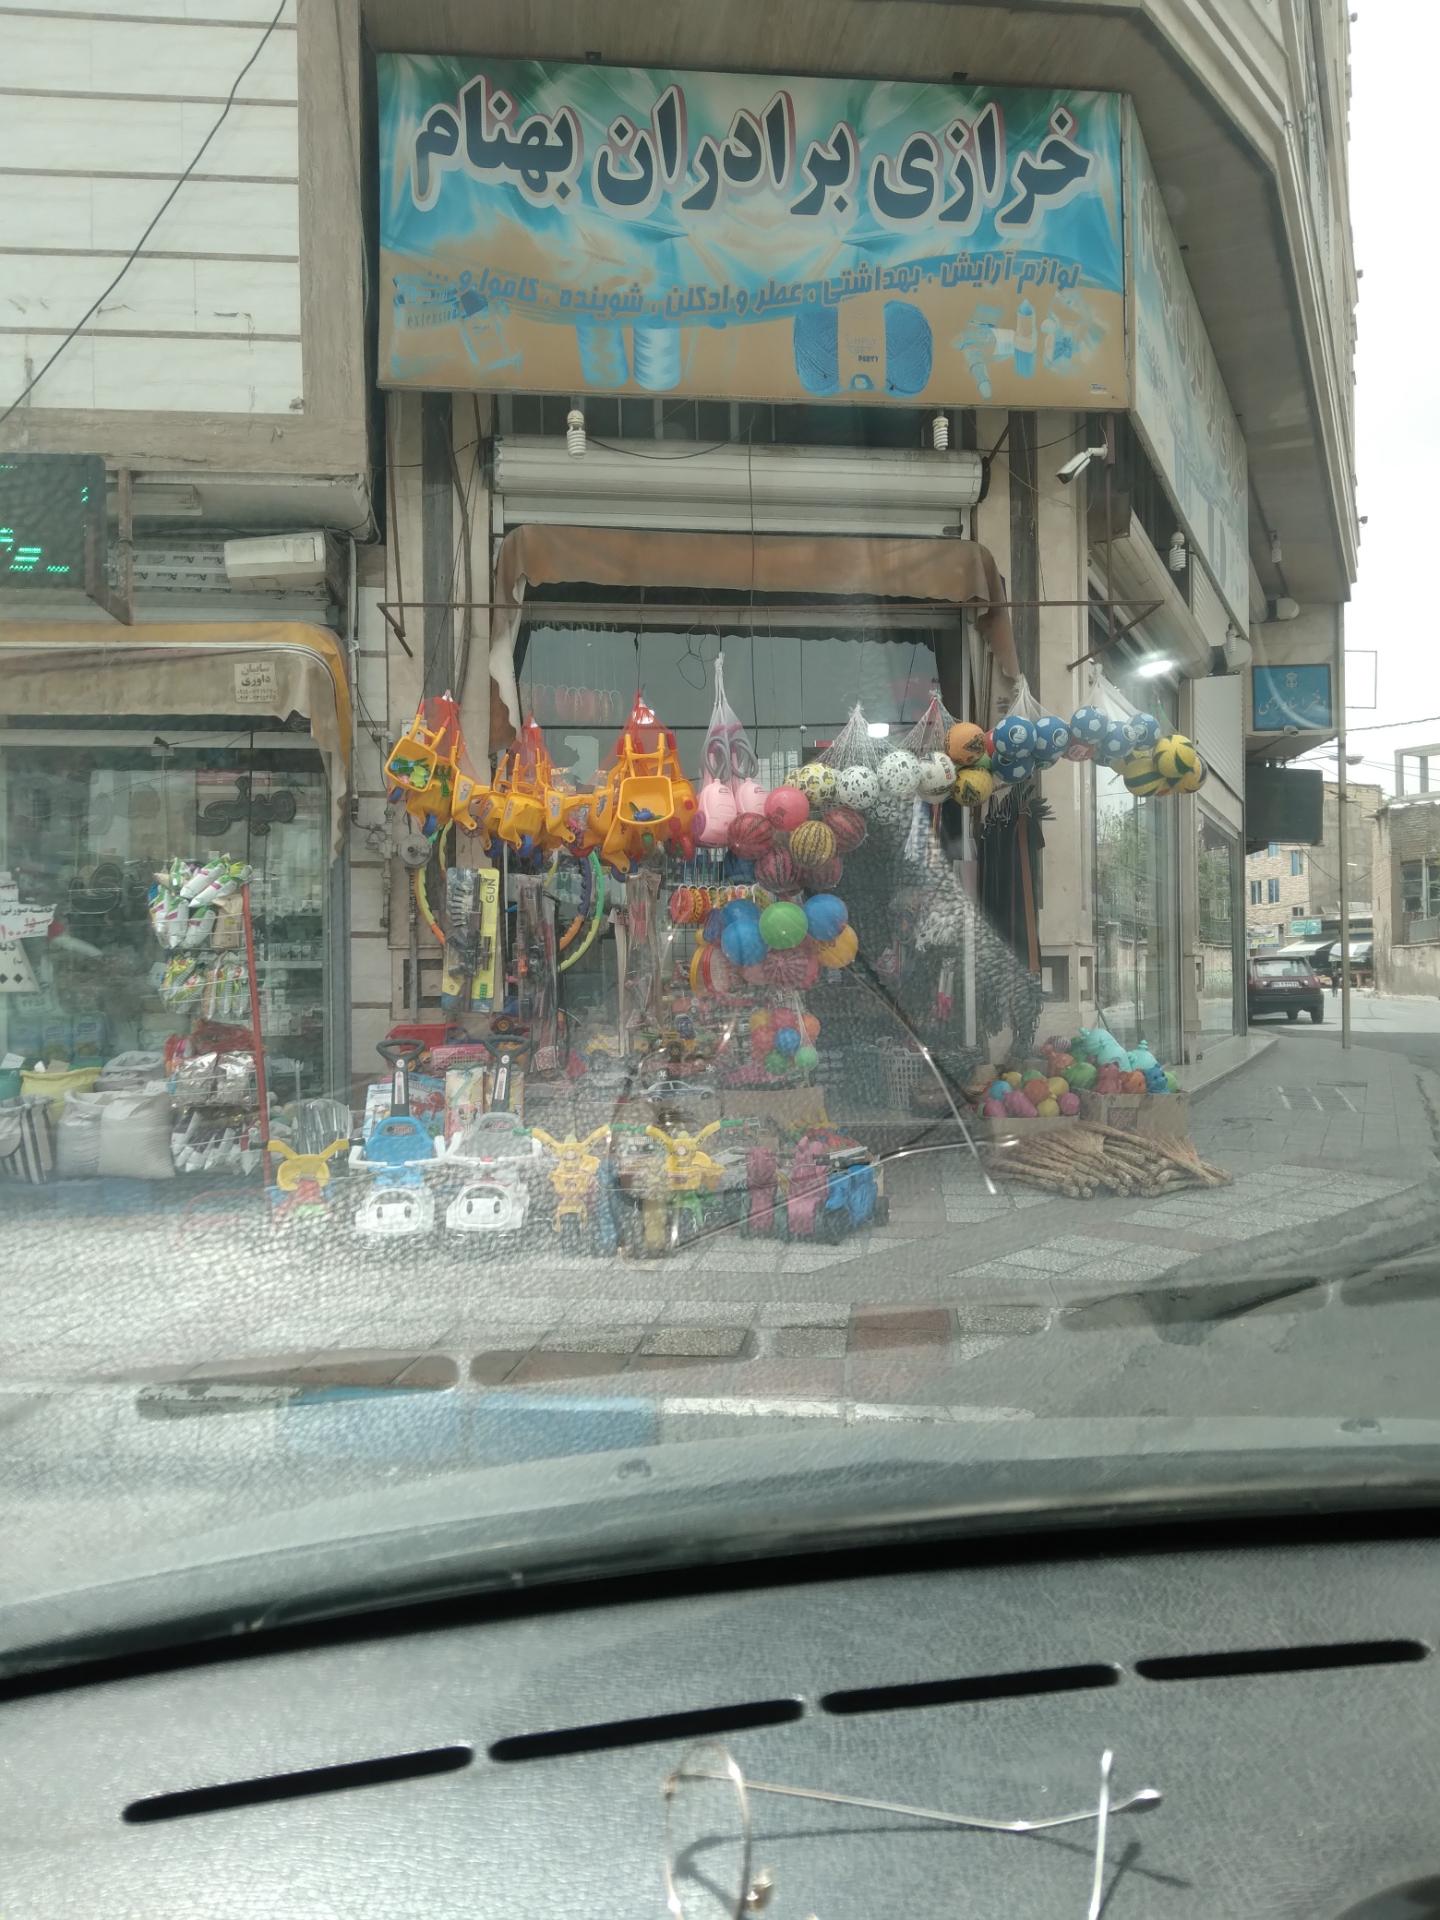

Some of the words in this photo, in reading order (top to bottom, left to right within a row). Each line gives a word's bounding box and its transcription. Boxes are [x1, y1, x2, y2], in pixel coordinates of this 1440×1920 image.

[413, 76, 577, 204] بهنام
[595, 86, 855, 217] برادران
[871, 102, 1093, 226] خرازی
[480, 267, 540, 303] کاموا
[1016, 258, 1081, 295] لوازم
[753, 279, 803, 313] عطر
[485, 878, 496, 904] GUN
